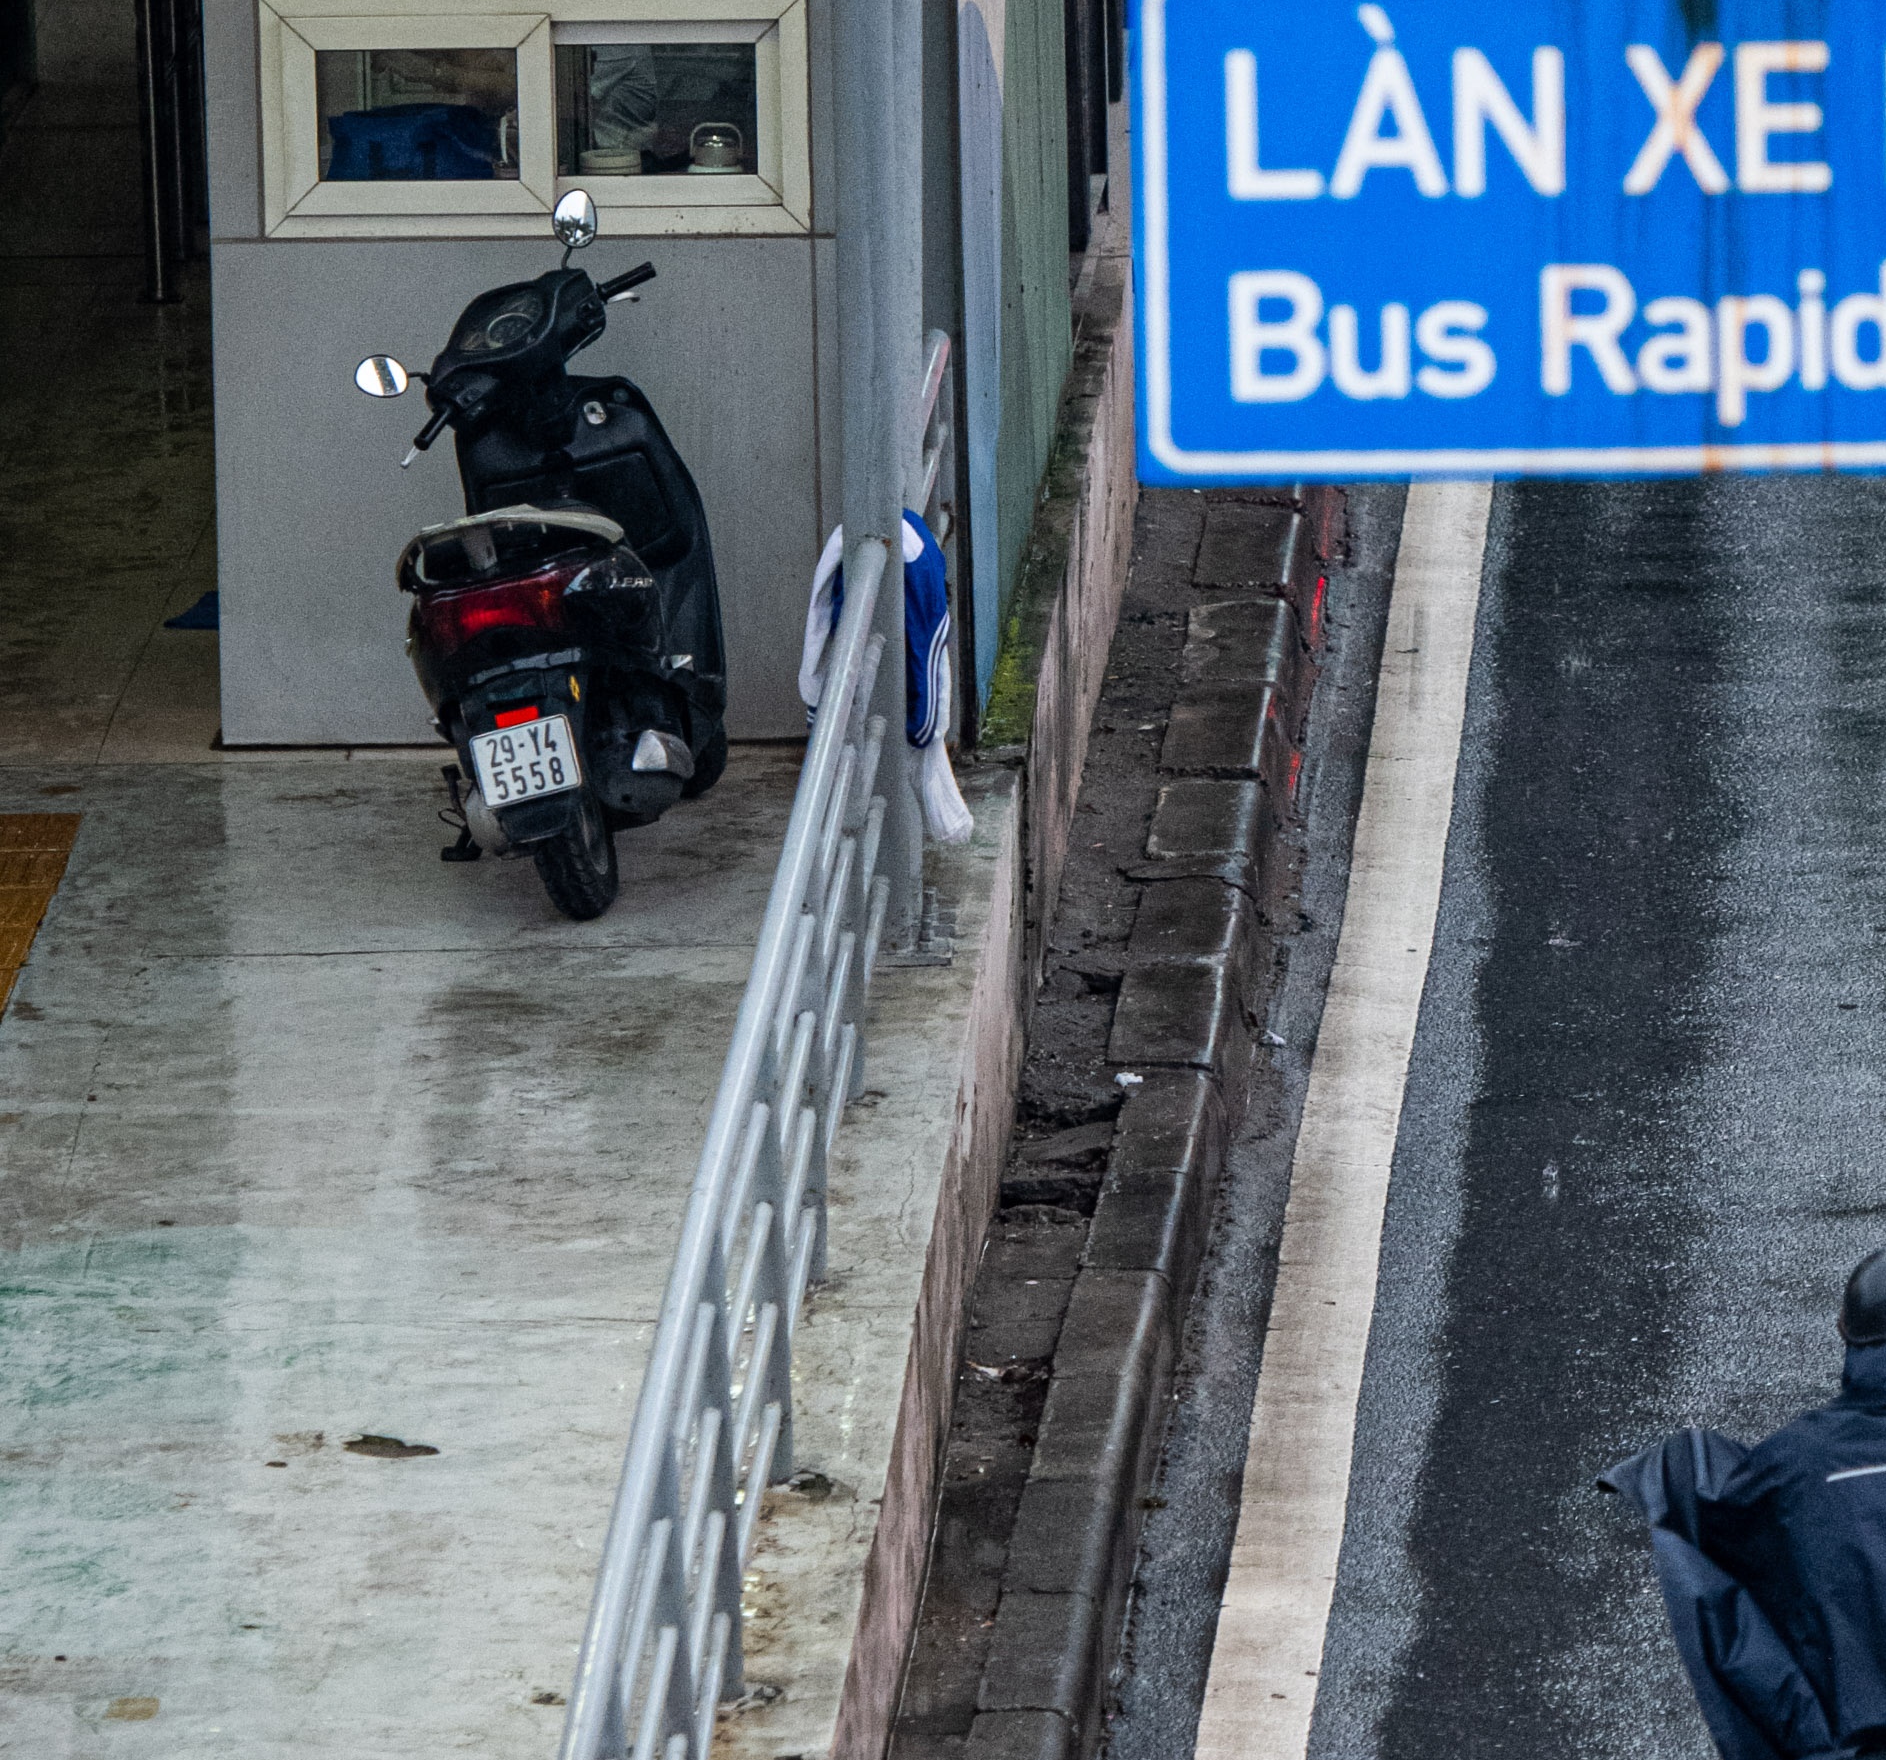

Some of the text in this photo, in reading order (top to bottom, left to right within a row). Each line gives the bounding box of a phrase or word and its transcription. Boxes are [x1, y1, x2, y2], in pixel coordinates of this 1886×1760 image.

[1224, 2, 1567, 201] LÀN
[1622, 41, 1832, 196] XE
[1226, 269, 1498, 404] Bus
[486, 722, 558, 769] 29-Y4
[492, 756, 566, 801] 5558
